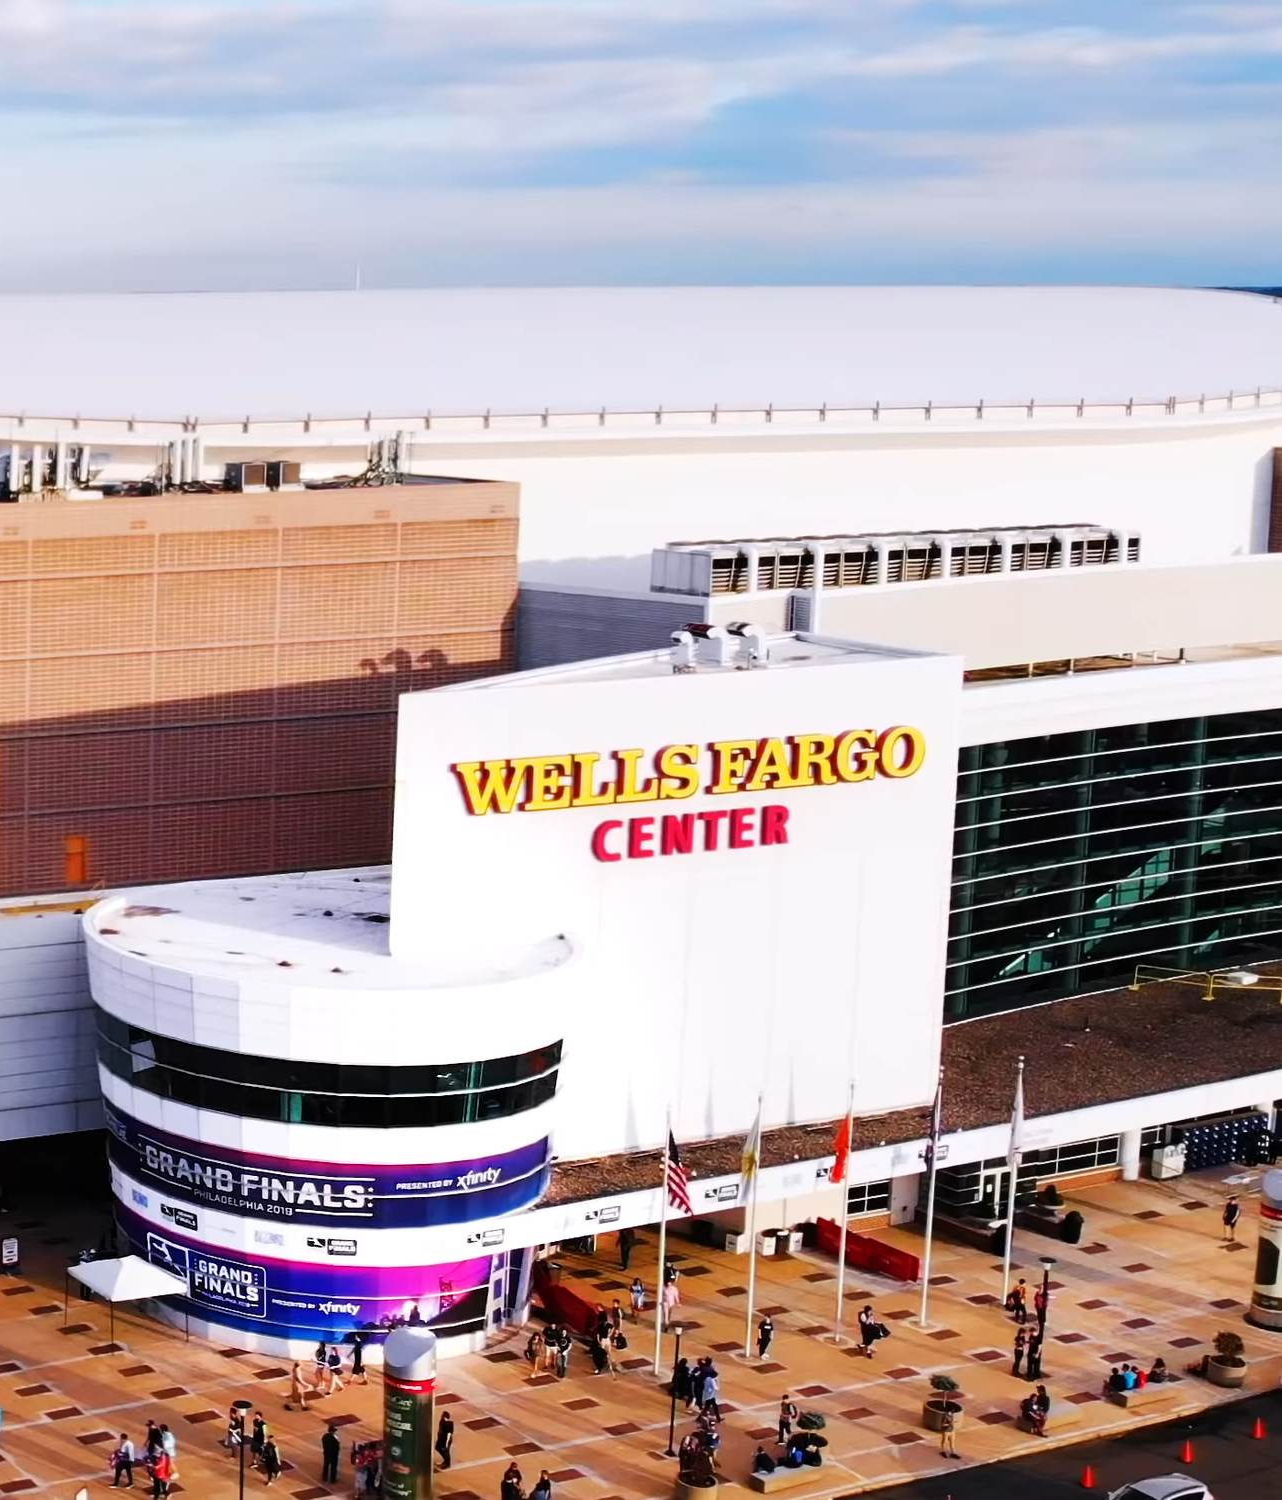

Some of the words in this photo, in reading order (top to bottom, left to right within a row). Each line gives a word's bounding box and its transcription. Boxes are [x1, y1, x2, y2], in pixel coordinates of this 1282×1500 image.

[452, 744, 699, 816] WELLS
[707, 726, 926, 795] FARGO
[591, 805, 791, 863] CENTER
[145, 1144, 233, 1193] GRAND
[396, 1180, 442, 1191] PRESENTED
[443, 1179, 454, 1188] BY
[456, 1166, 502, 1192] xfinity
[193, 1188, 264, 1212] PHILADELPHIA
[198, 1259, 253, 1285] GRAND
[194, 1271, 259, 1302] FINALS
[318, 1301, 361, 1316] xfinity
